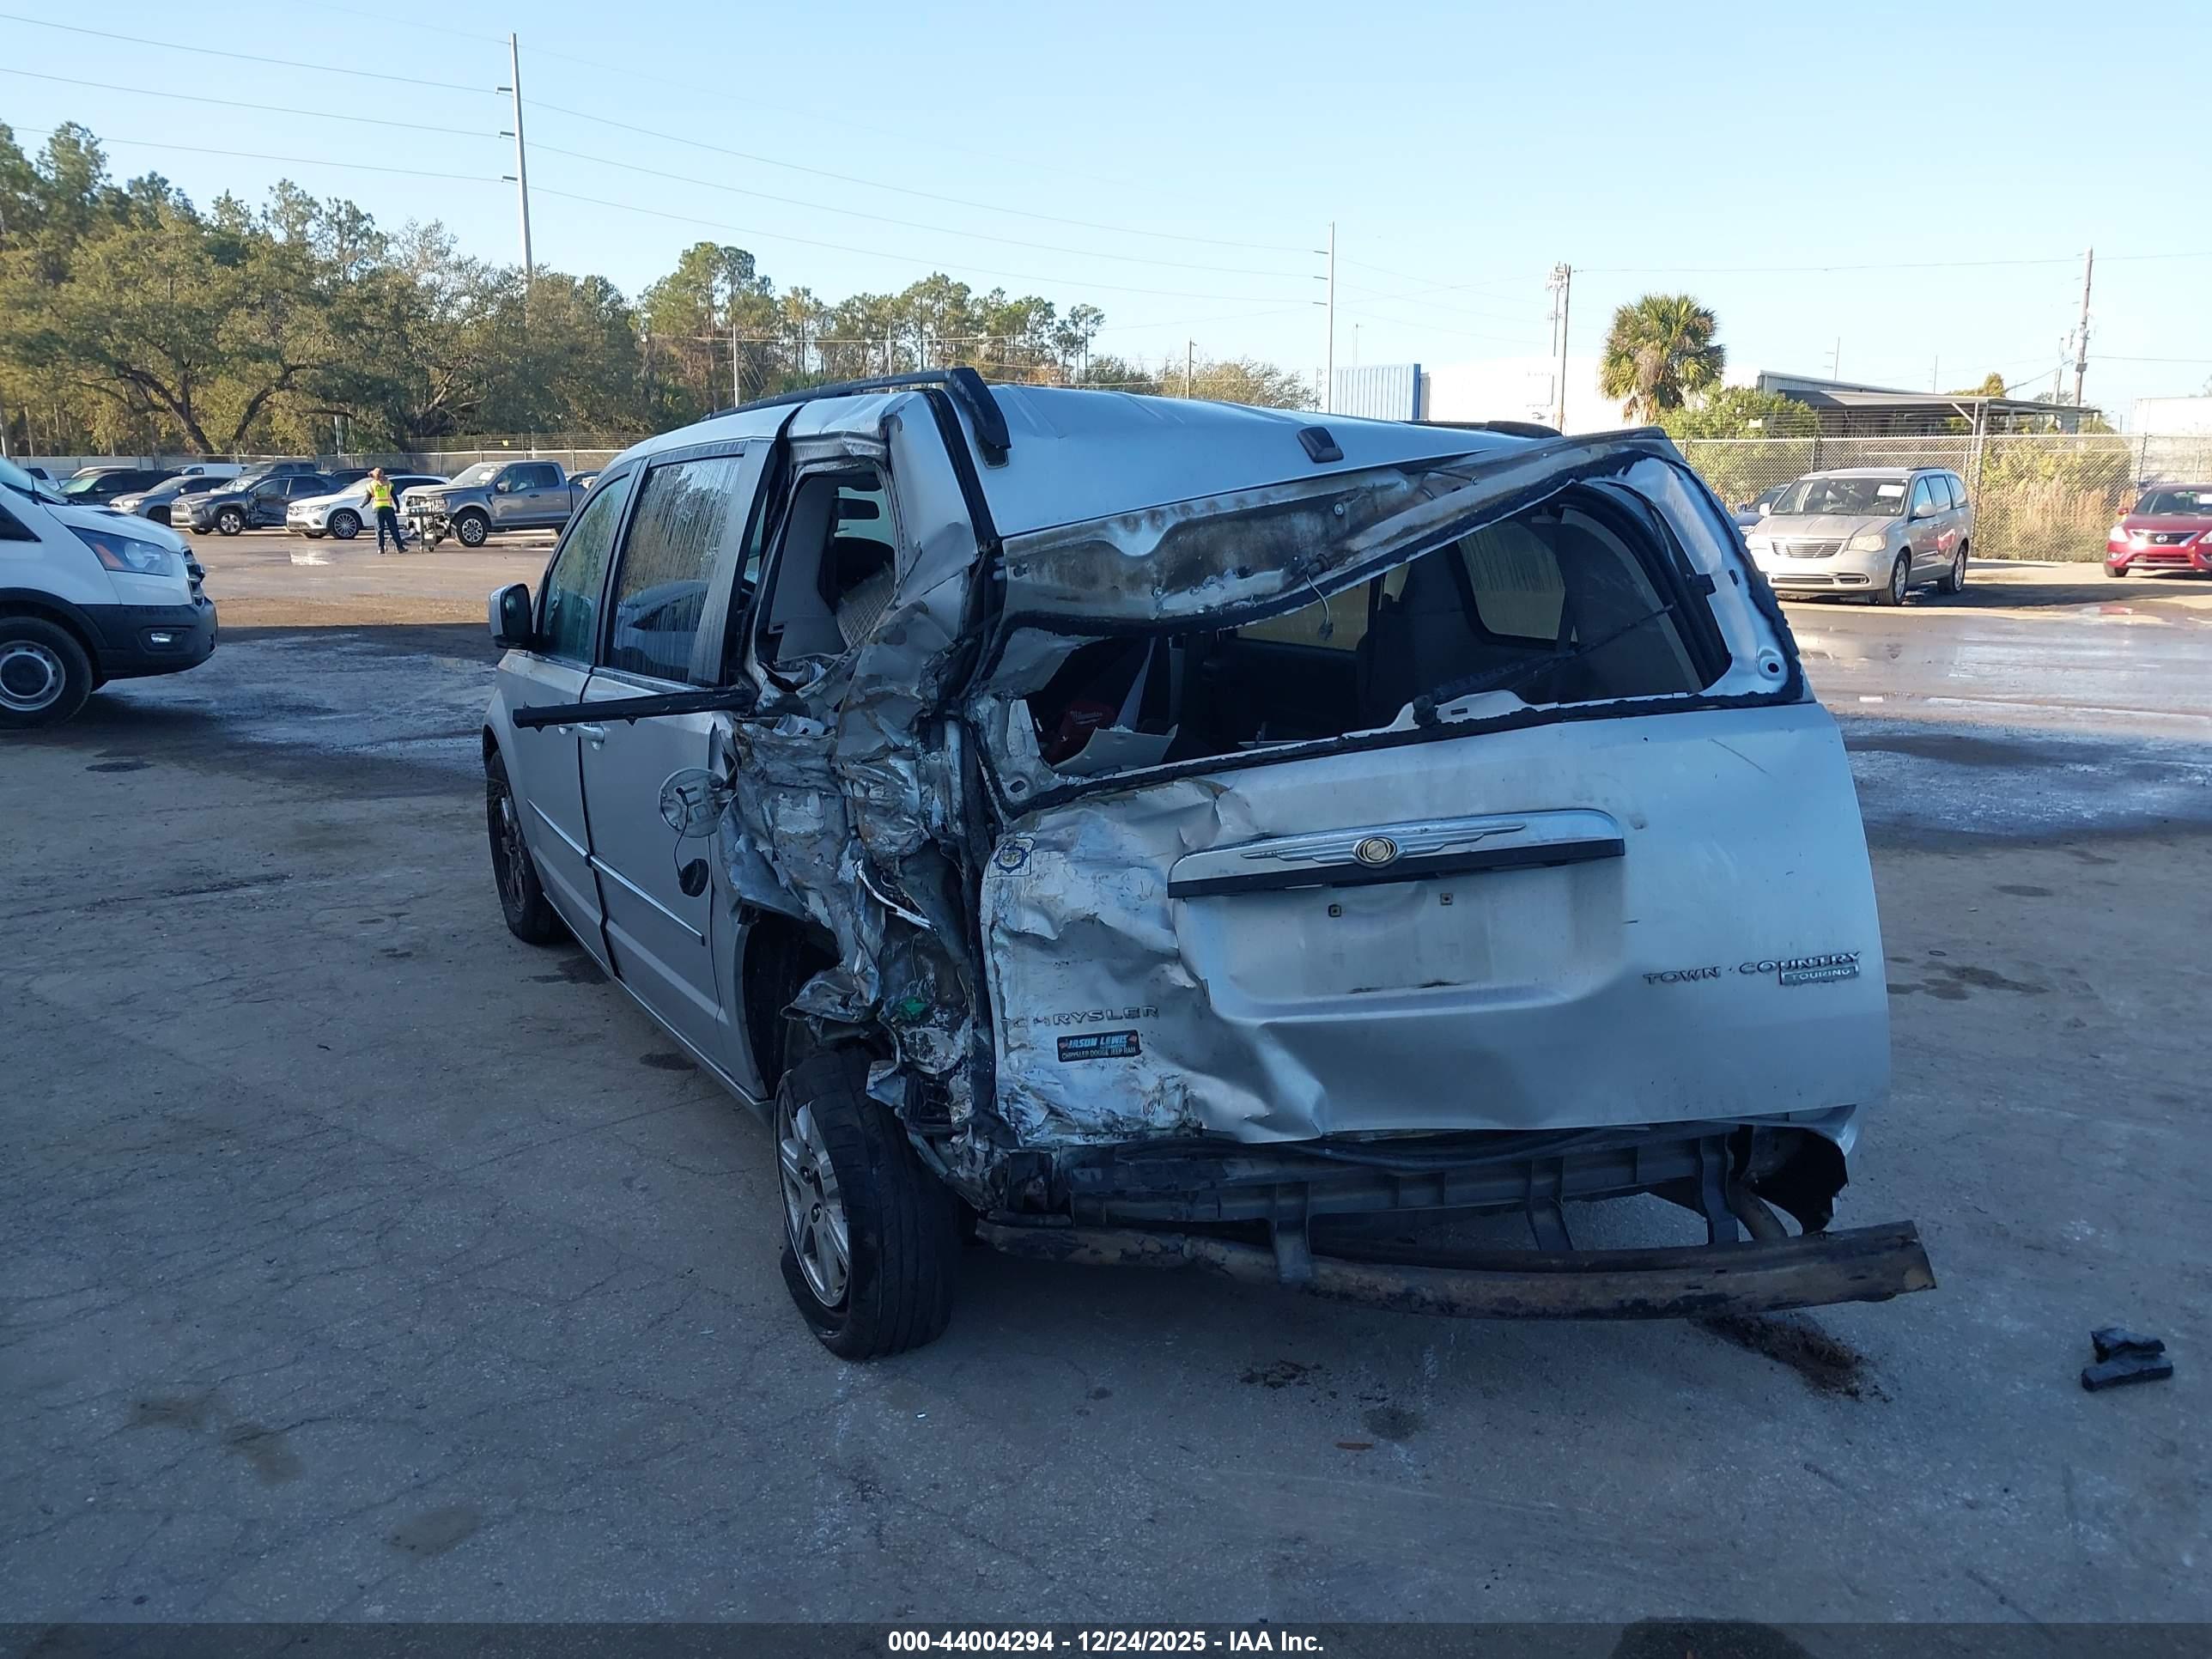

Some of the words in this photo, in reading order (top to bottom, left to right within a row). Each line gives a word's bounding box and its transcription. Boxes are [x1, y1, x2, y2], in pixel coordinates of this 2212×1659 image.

[1642, 965, 1722, 985] TOWN
[1739, 951, 1862, 975] COUNTRY
[1792, 968, 1851, 981] TOURING
[1067, 1037, 1099, 1049] JASON
